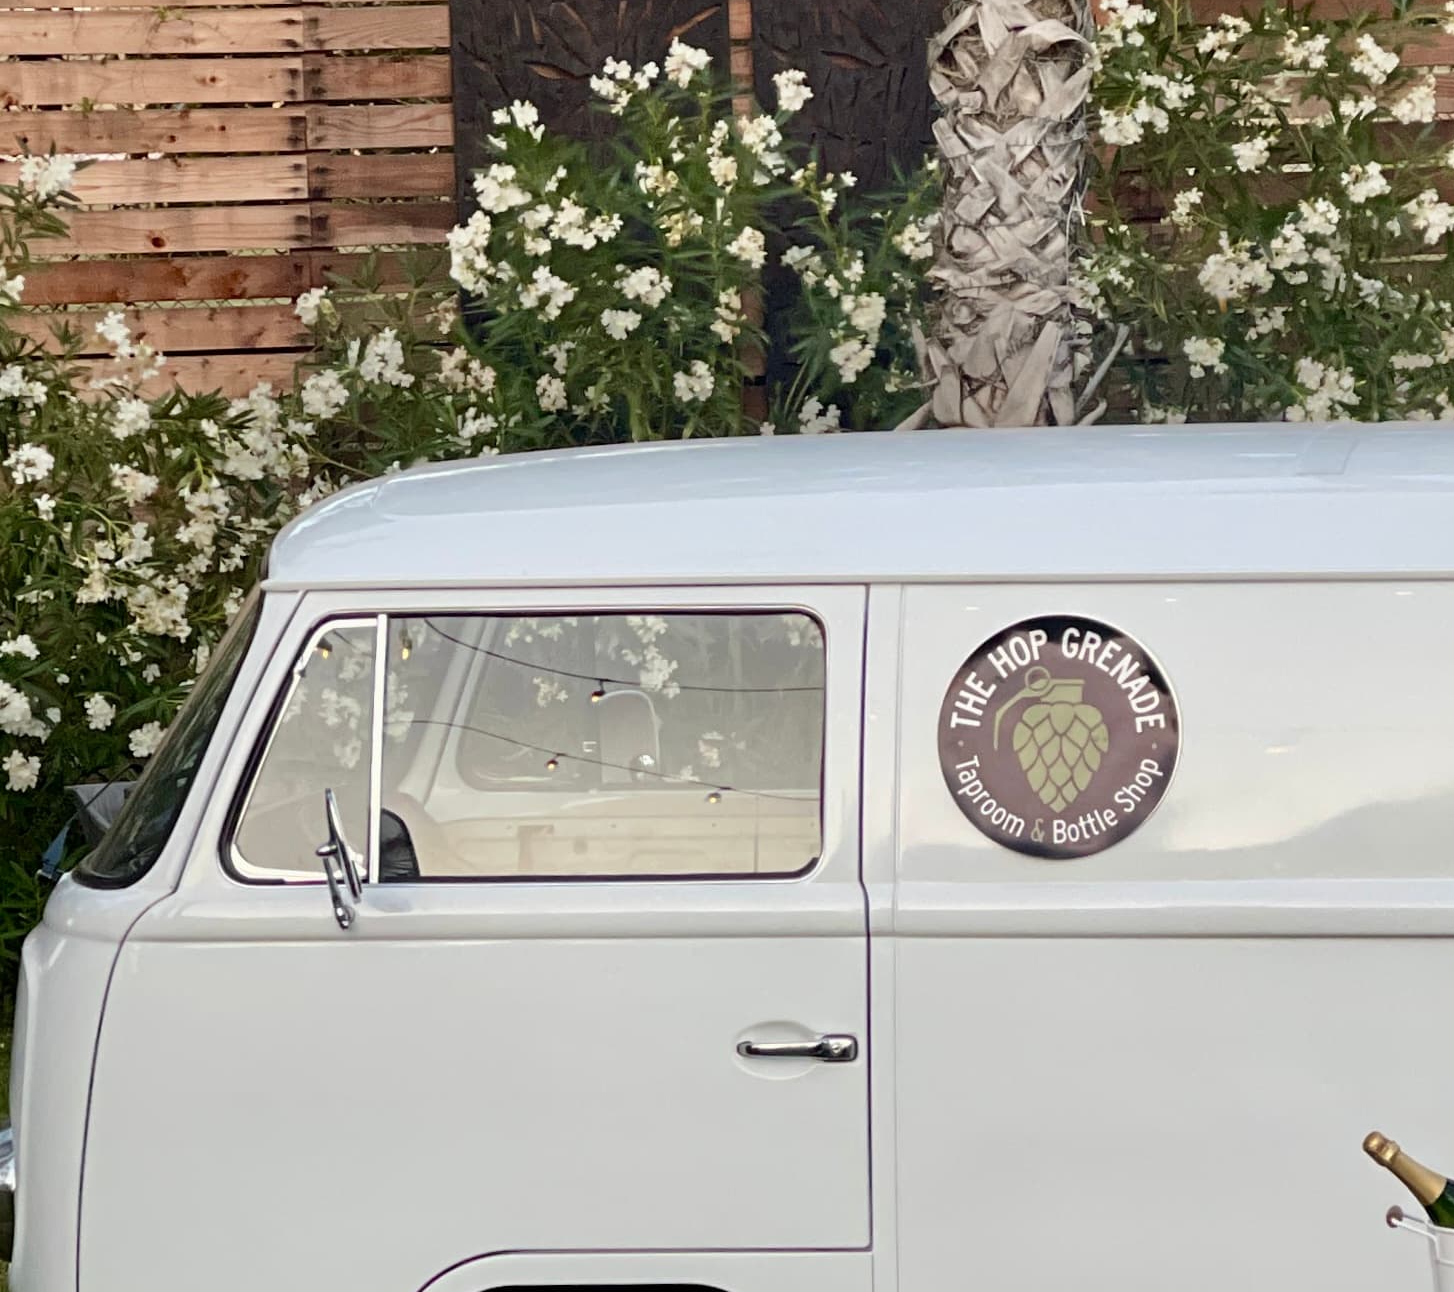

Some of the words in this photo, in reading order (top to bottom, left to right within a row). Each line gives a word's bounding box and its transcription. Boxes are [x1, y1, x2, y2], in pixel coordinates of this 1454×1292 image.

[950, 671, 997, 729] THE
[987, 628, 1048, 679] HOP
[1061, 626, 1166, 733] GRENADE
[955, 755, 1025, 837] Taproom
[1030, 818, 1046, 842] &
[1053, 808, 1119, 844] Bottle
[1114, 758, 1164, 813] Shop
